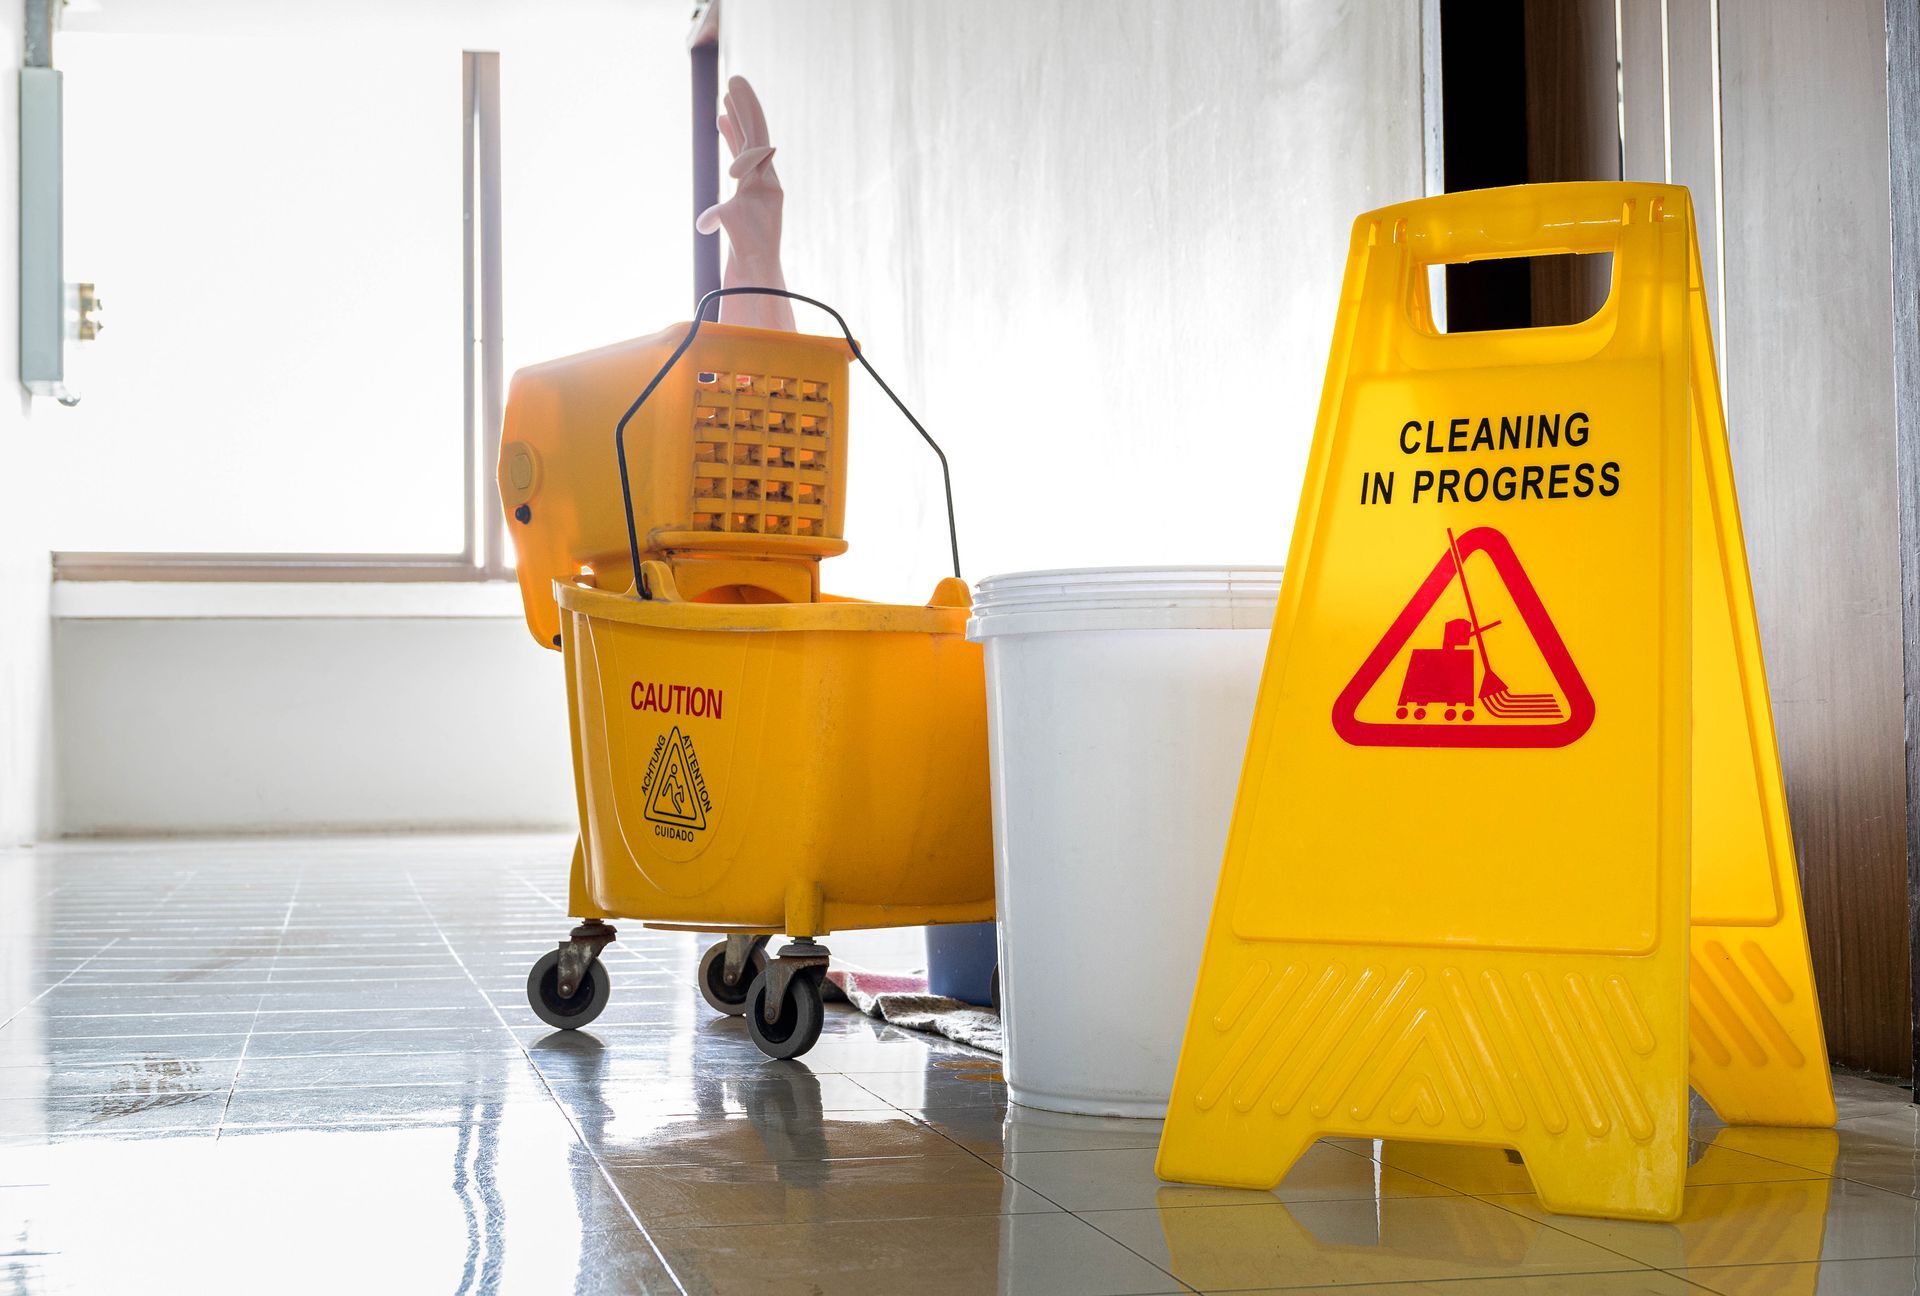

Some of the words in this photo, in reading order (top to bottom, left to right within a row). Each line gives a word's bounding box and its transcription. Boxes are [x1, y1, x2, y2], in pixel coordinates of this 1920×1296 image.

[1399, 412, 1590, 454] CLEANING
[1360, 471, 1395, 505] IN
[1412, 461, 1621, 504] PROGRESS
[630, 680, 723, 720] CAUTION
[641, 733, 667, 797] ACHTUNG
[681, 734, 713, 814] ATTENTION
[654, 824, 695, 843] CUIDADO
